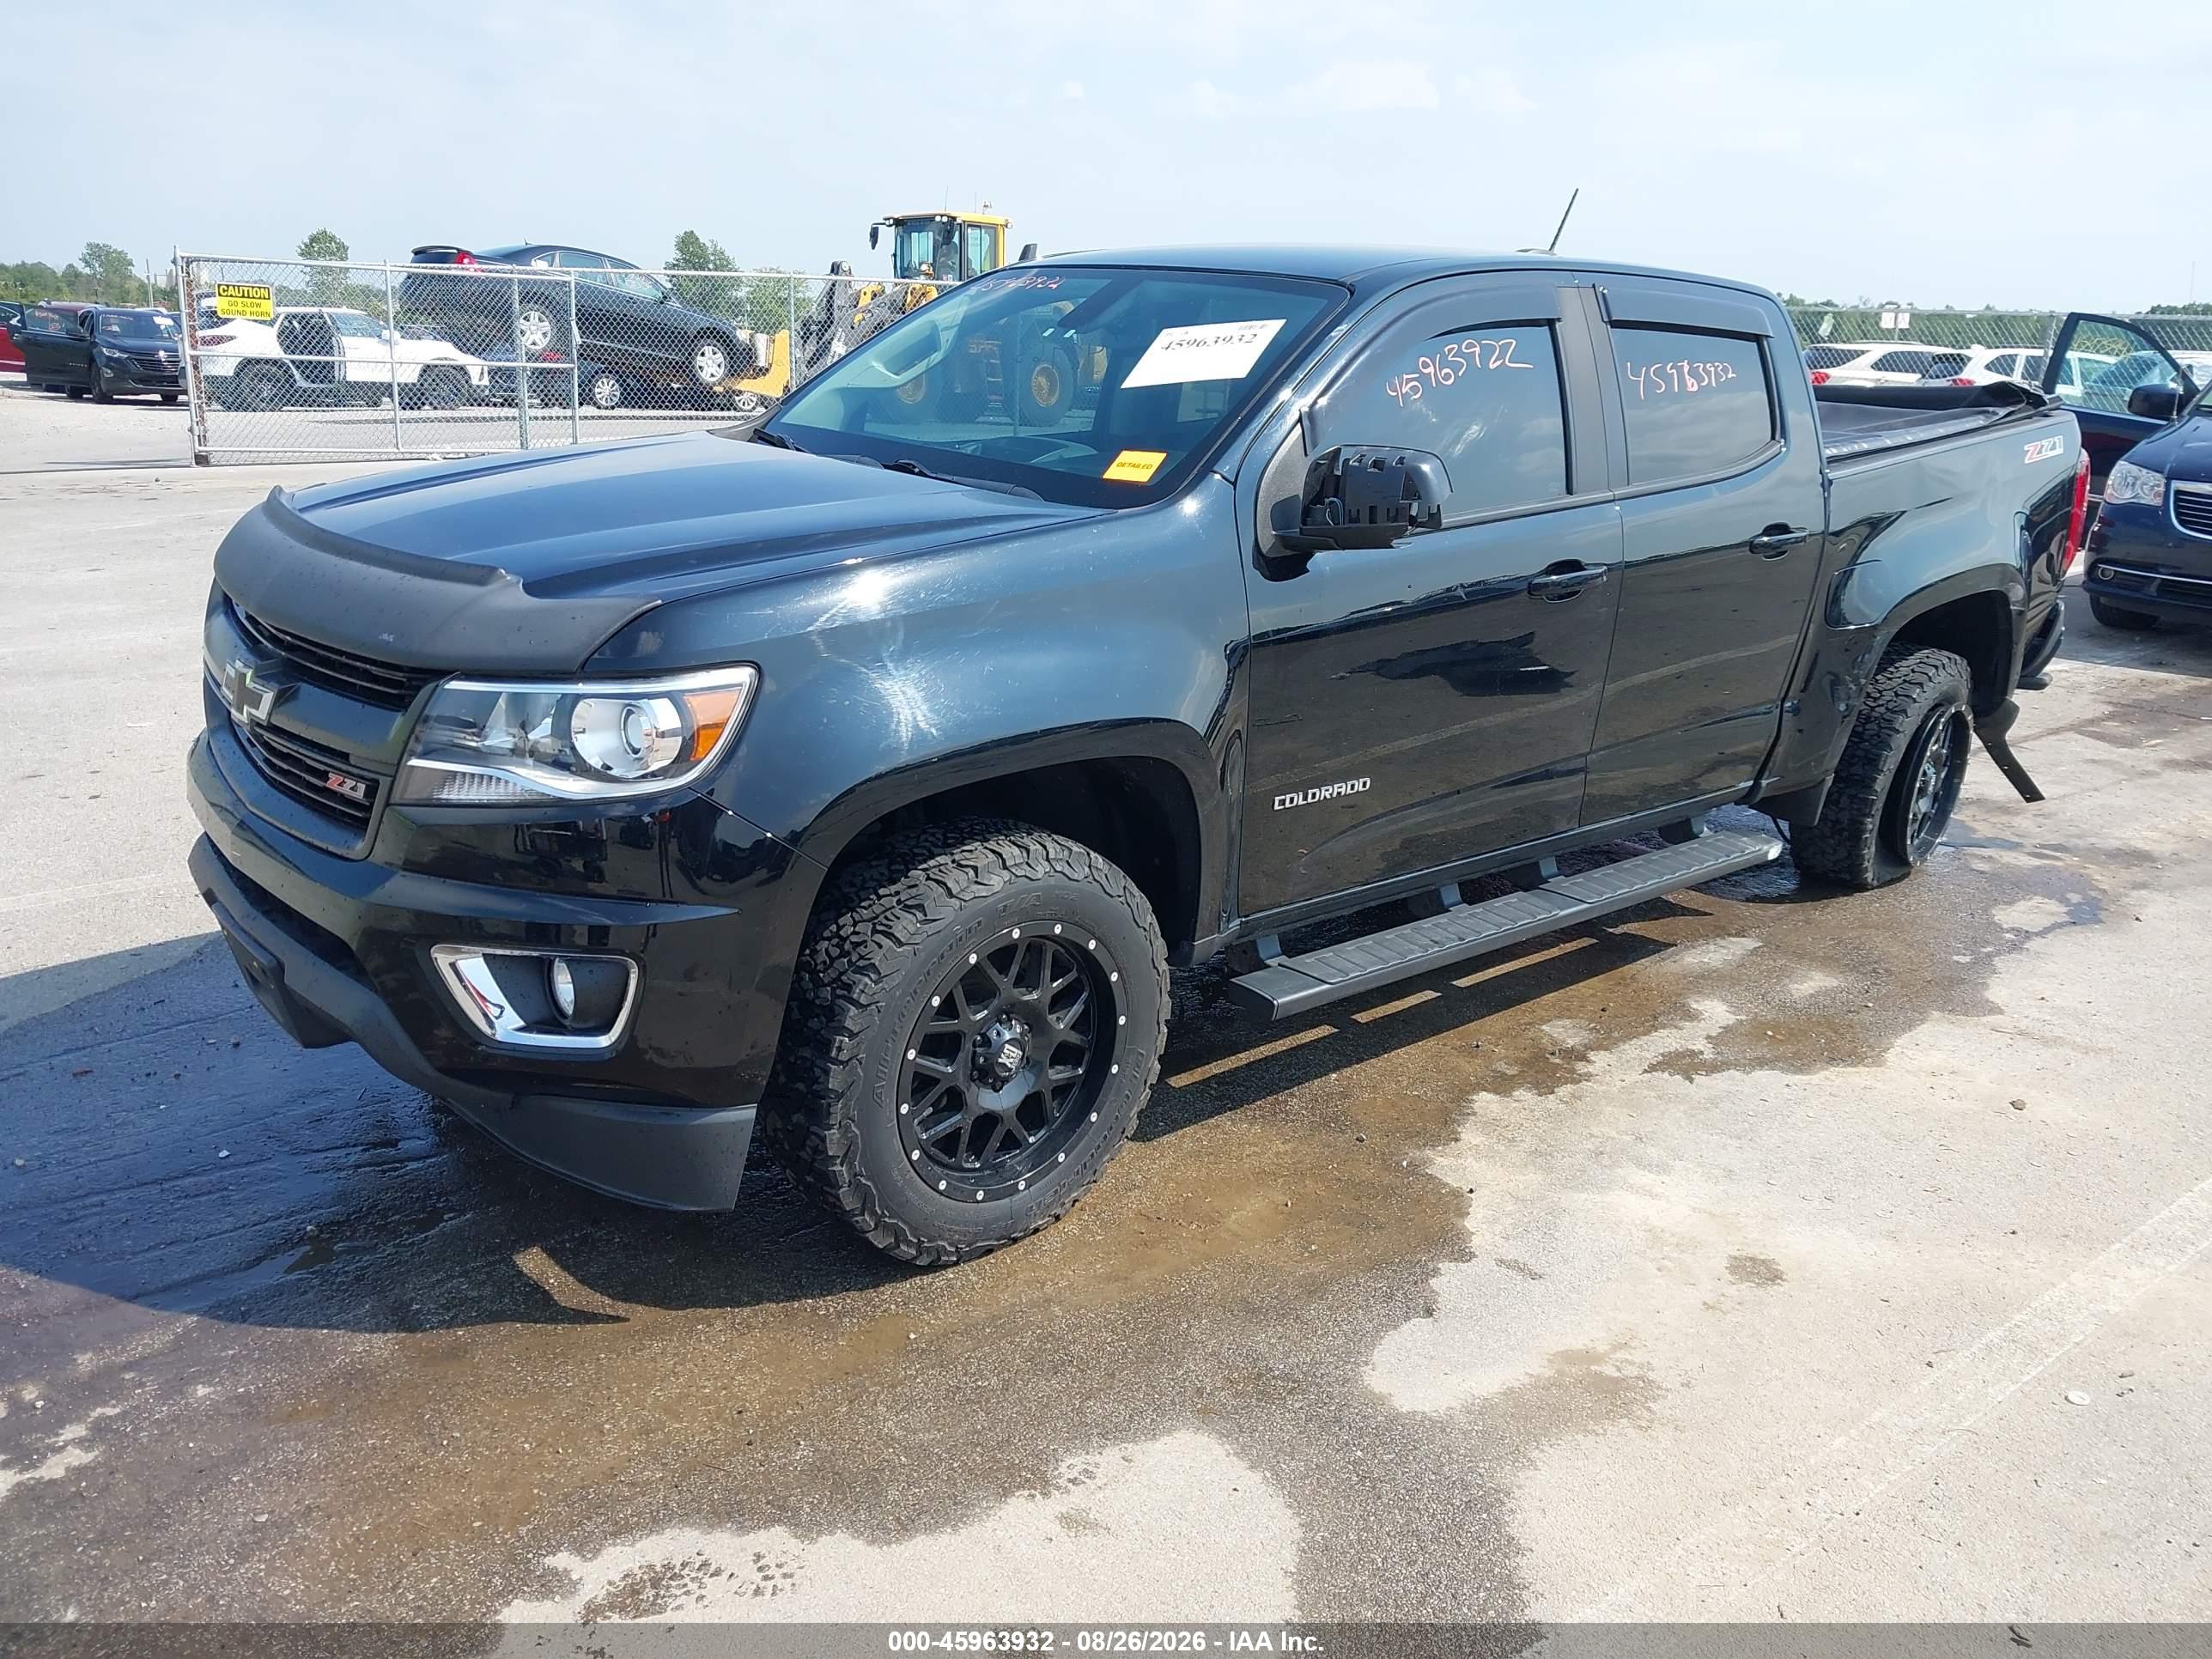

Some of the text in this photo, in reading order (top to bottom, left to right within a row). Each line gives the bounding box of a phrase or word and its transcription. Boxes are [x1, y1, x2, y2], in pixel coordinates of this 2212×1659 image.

[219, 285, 270, 300] CAUTION
[221, 308, 247, 317] SOUND
[1160, 333, 1258, 351] 45963932
[2023, 434, 2064, 465] Z71
[1116, 461, 1153, 470] DETAILED
[326, 772, 366, 799] Z71
[1273, 777, 1371, 811] COLORADO
